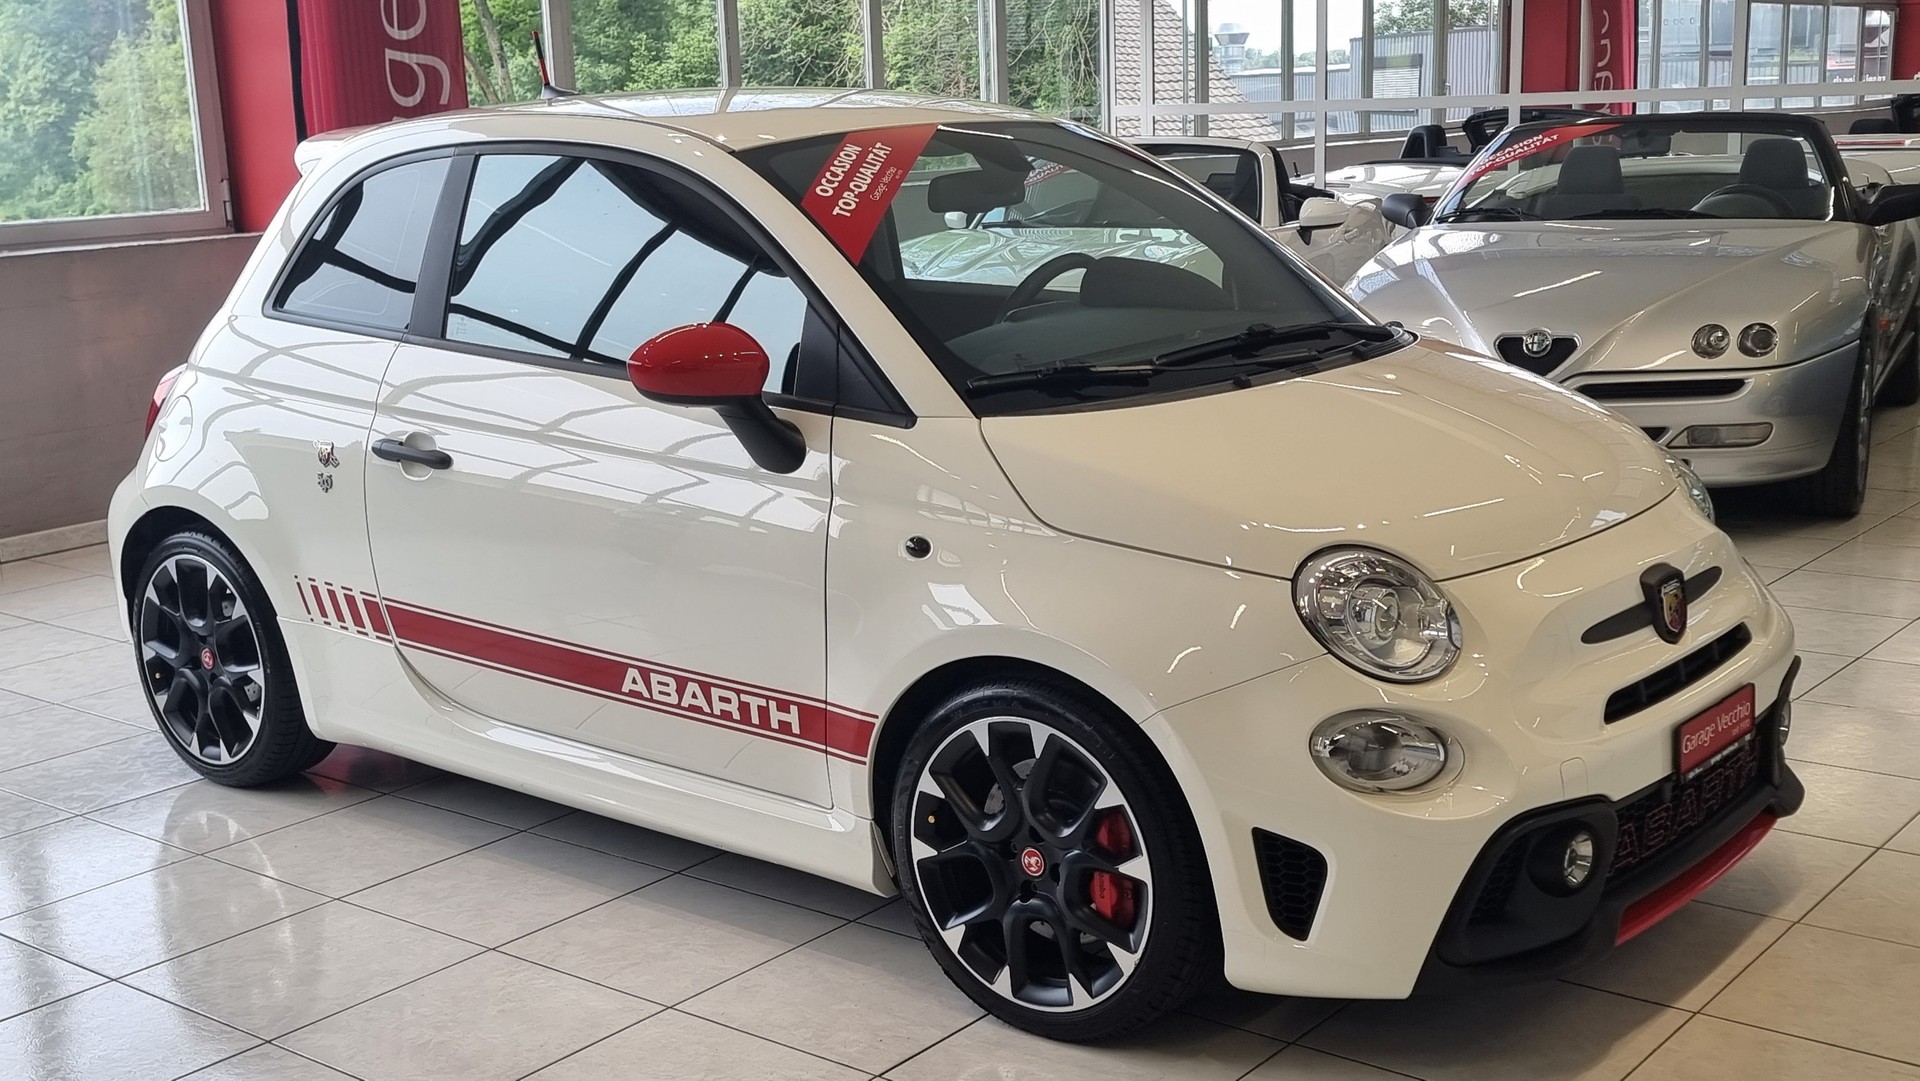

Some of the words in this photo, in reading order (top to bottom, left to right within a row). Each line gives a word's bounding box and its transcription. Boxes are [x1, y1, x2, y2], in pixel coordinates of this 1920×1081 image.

[381, 0, 451, 121] ge
[815, 143, 863, 197] OCCASION
[832, 142, 893, 217] TOP-QUALITÄT
[621, 667, 801, 735] ABARTH
[1682, 723, 1716, 754] Garage
[1716, 701, 1751, 732] Vecchio
